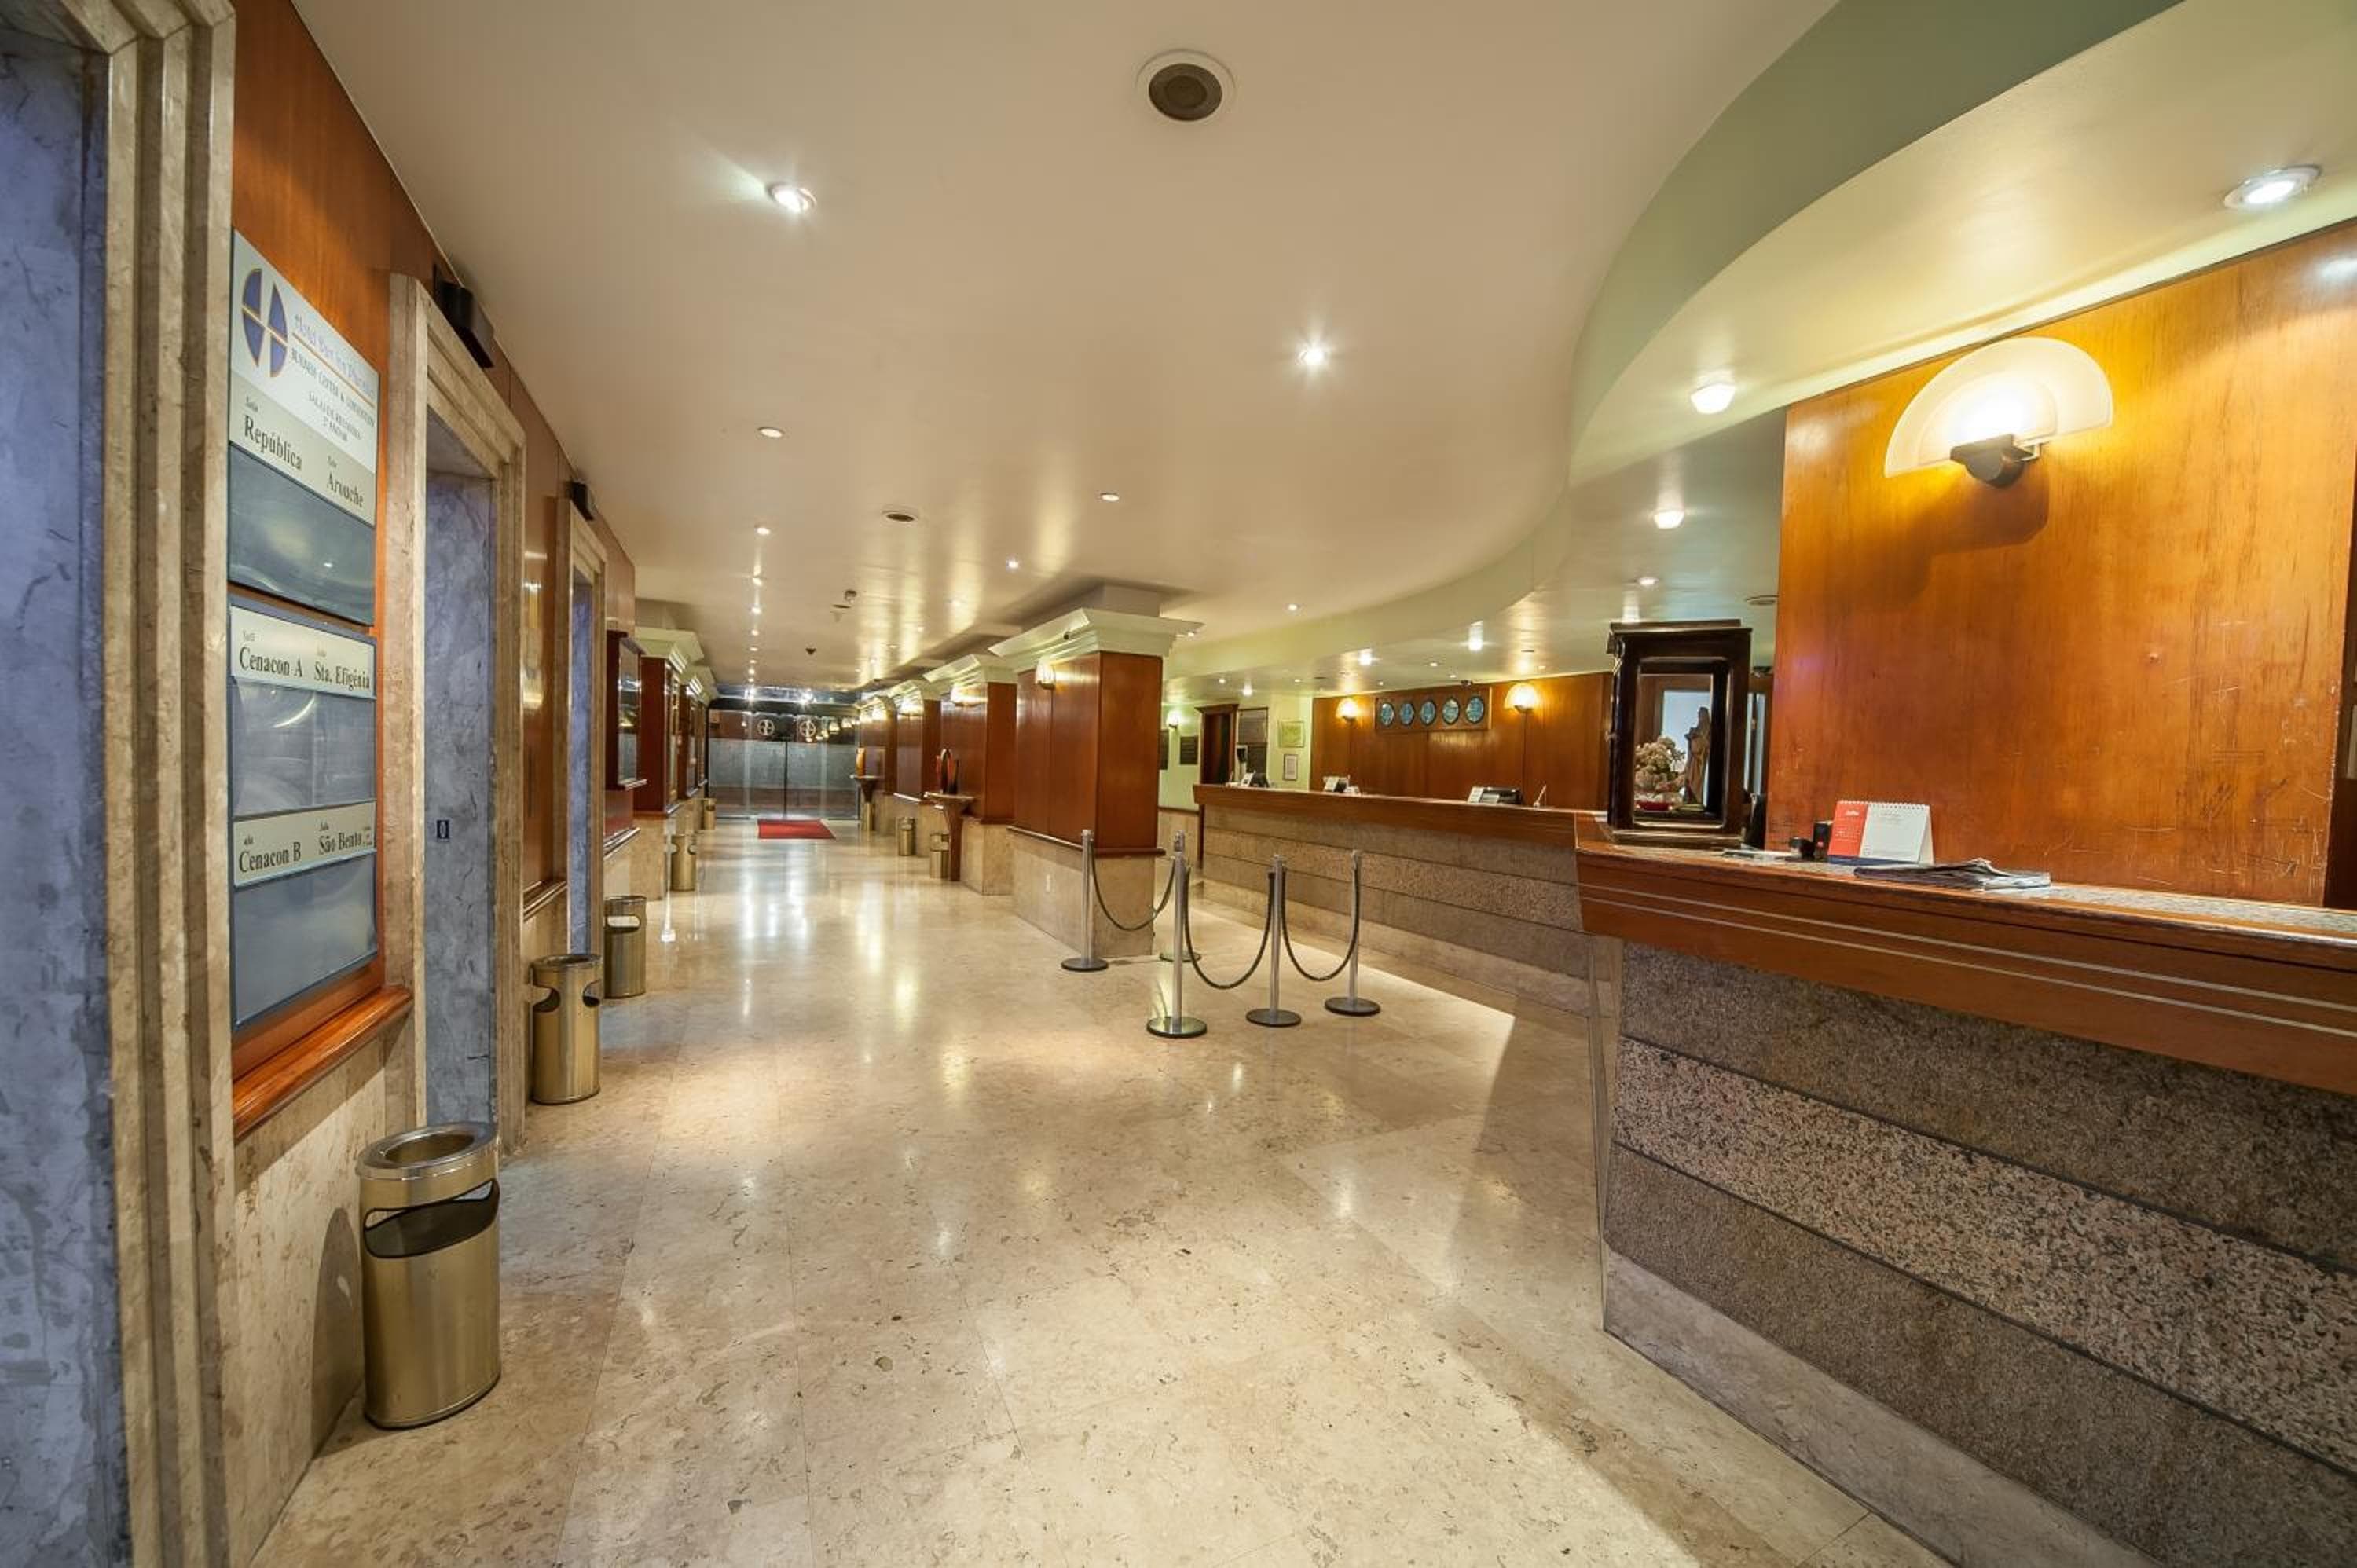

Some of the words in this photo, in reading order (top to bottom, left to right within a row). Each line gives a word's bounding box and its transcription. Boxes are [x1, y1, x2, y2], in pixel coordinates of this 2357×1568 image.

[244, 415, 302, 470] República
[327, 472, 364, 508] Arouche
[240, 647, 290, 676] Cenacon
[293, 658, 302, 677] A
[239, 850, 290, 873] Cenacon
[293, 841, 302, 862] B
